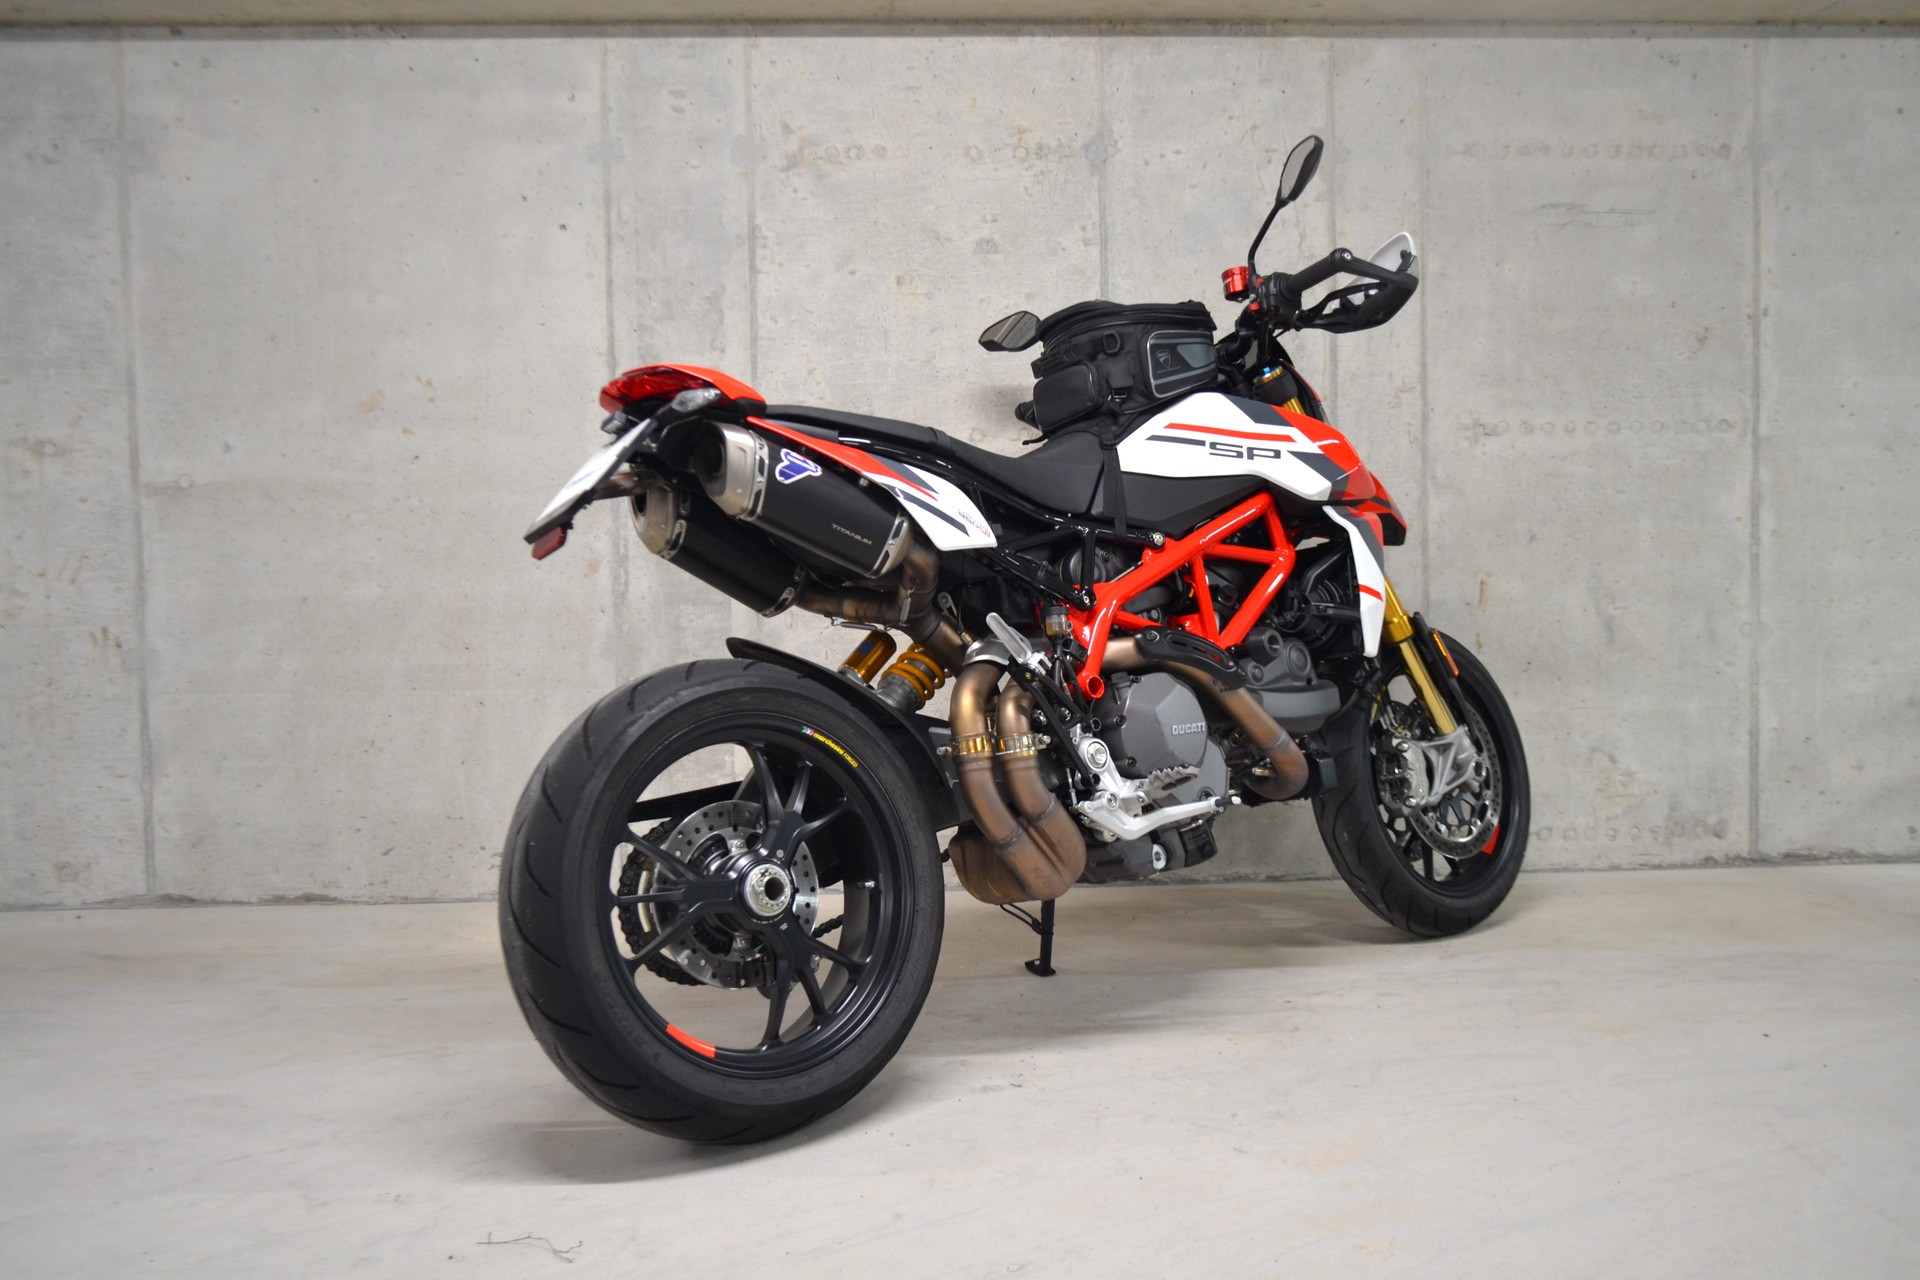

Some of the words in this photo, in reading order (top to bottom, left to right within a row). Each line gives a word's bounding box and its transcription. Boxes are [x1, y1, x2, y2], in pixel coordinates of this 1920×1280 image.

[1209, 441, 1282, 461] SP
[1172, 721, 1206, 736] DUCATI
[813, 732, 846, 756] marchesini
